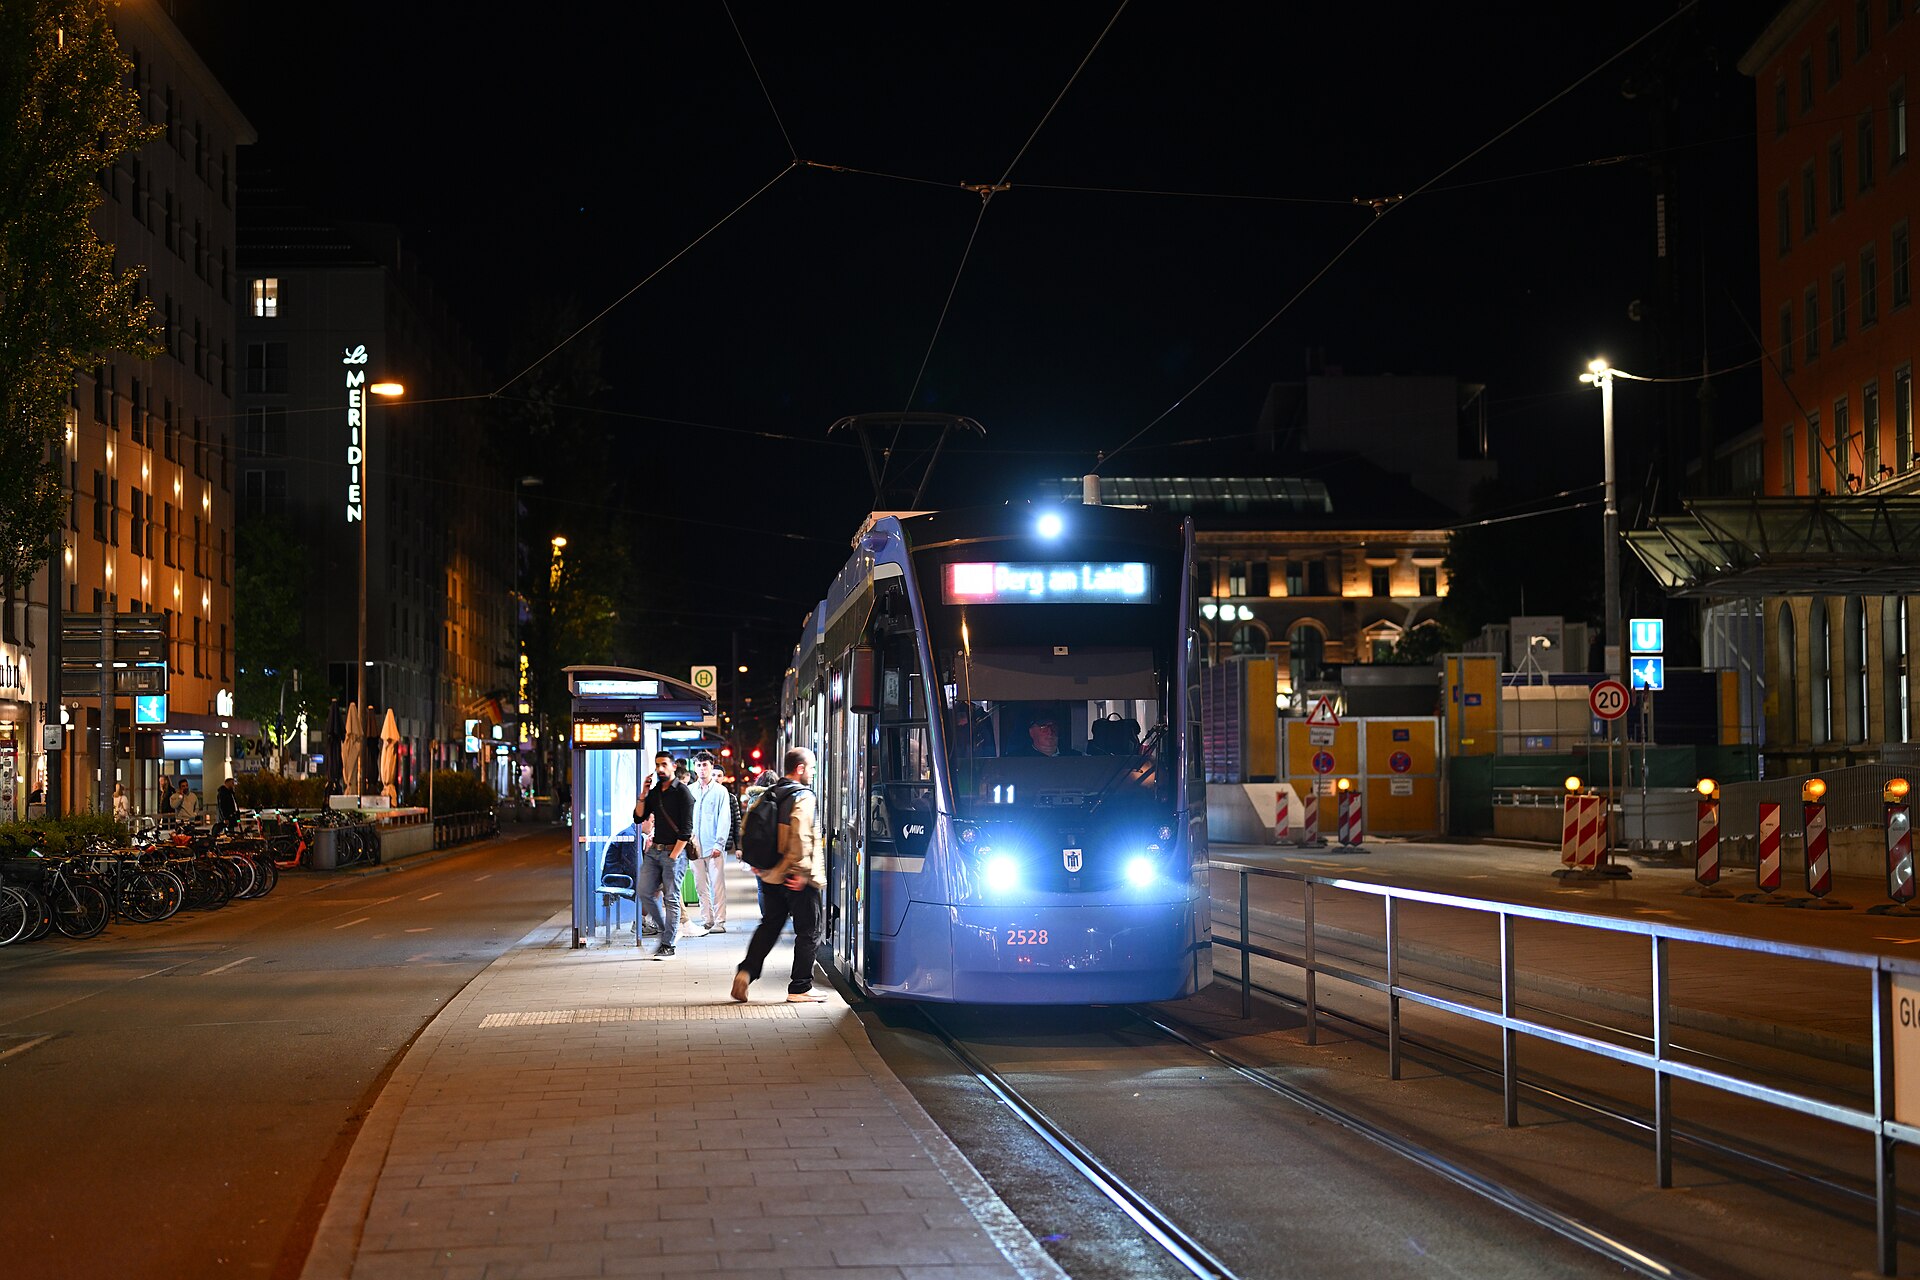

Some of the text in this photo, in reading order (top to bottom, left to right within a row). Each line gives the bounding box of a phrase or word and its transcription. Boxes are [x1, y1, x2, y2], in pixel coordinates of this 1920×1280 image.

[342, 344, 368, 523] Le MERIDIEN
[995, 566, 1044, 595] Berg
[1199, 604, 1254, 621] TEL
[1636, 623, 1657, 649] U
[1598, 691, 1621, 709] 20
[1593, 721, 1600, 733] U
[993, 784, 1014, 804] 11
[908, 824, 925, 835] MVG
[1006, 929, 1049, 946] 2528
[1899, 997, 1920, 1029] Gl
